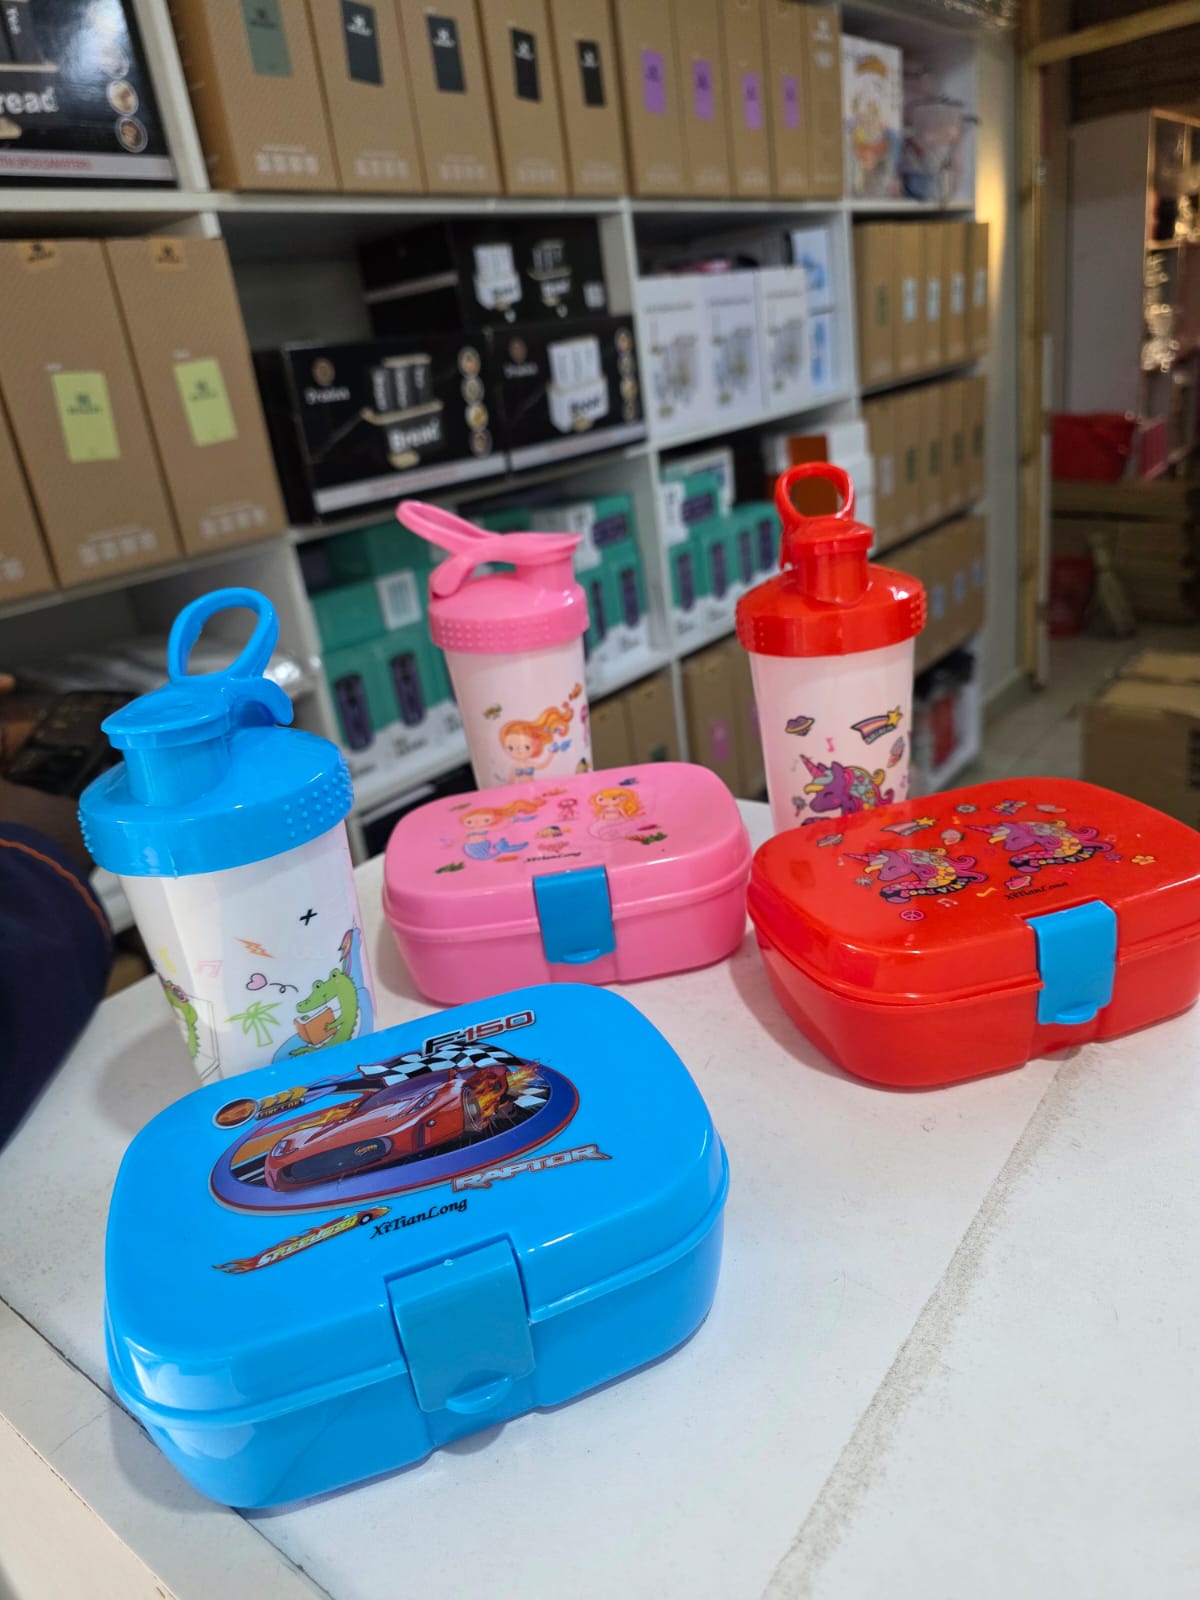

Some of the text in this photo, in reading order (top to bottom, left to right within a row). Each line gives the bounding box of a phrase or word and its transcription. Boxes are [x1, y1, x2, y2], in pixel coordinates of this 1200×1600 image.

[424, 1010, 535, 1056] F-150
[453, 1144, 612, 1192] RAPTOR
[370, 1198, 468, 1239] XiTianLong
